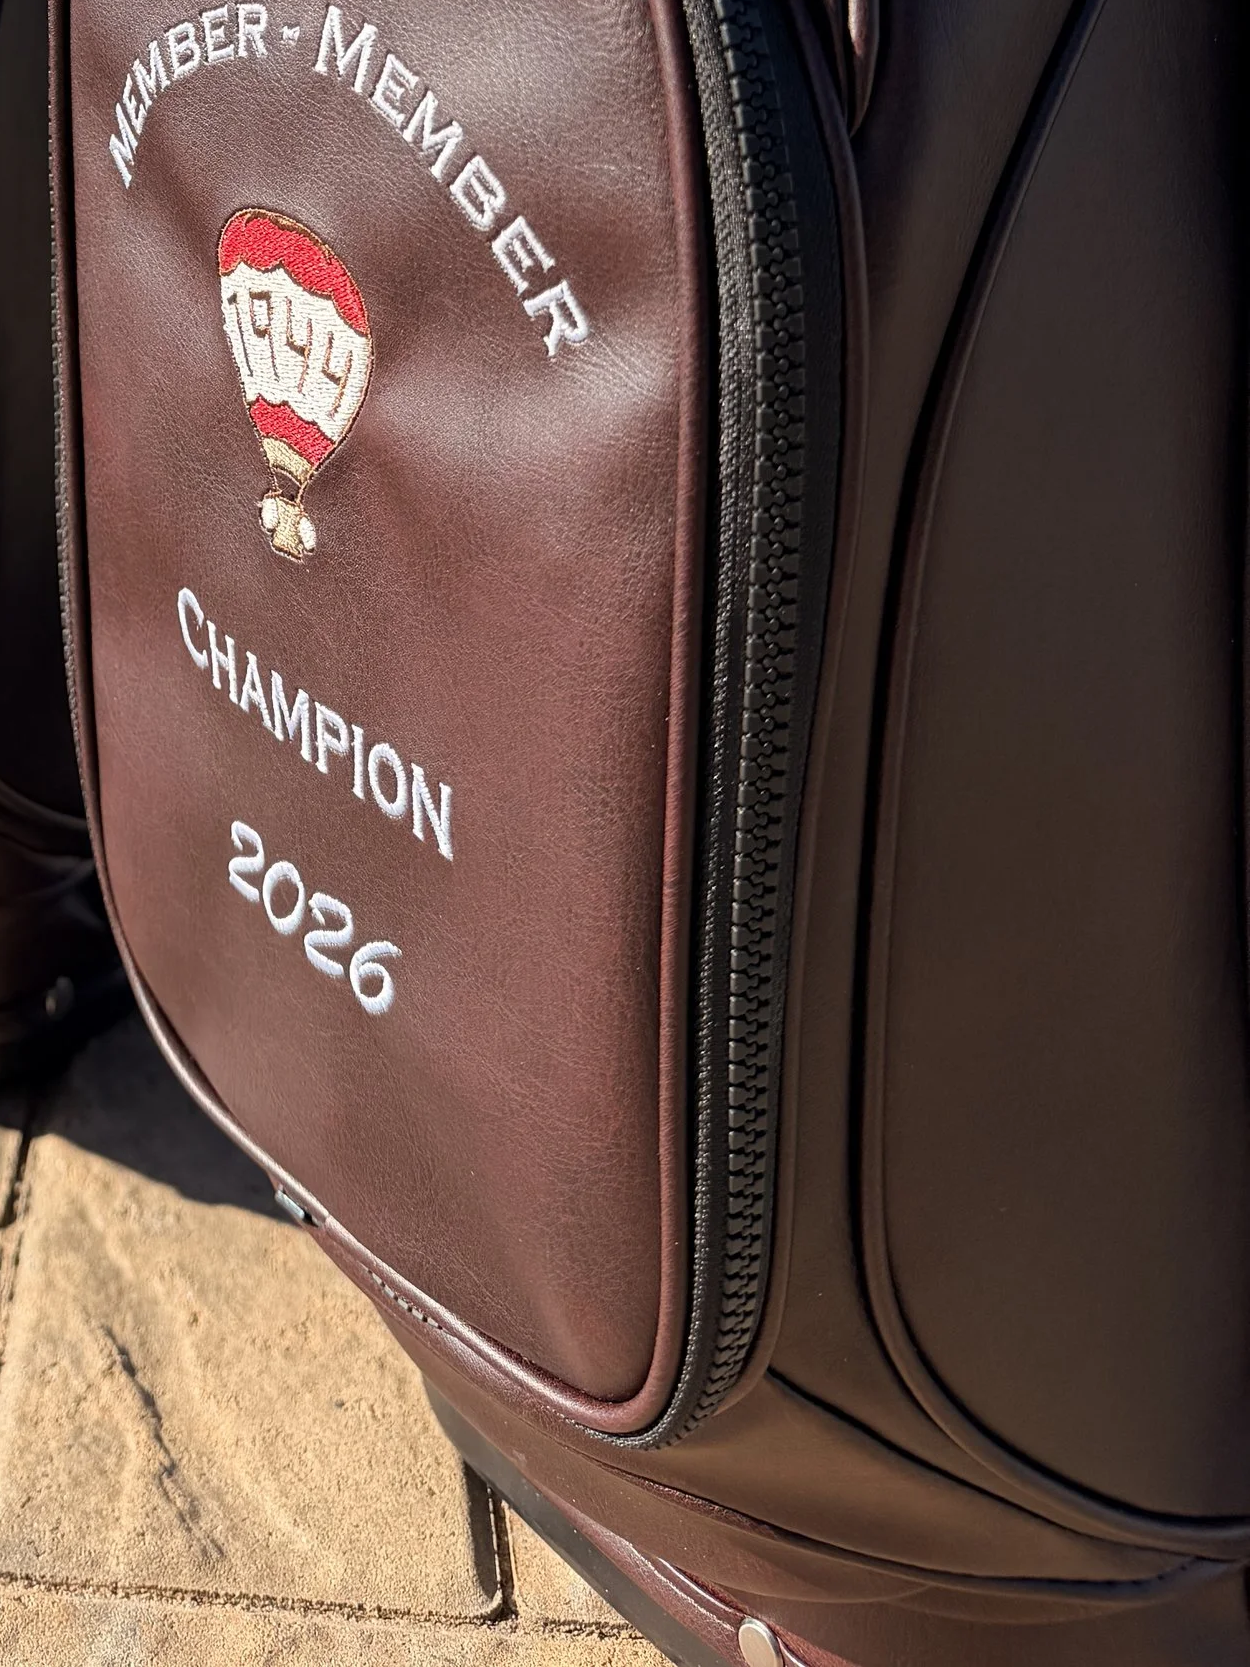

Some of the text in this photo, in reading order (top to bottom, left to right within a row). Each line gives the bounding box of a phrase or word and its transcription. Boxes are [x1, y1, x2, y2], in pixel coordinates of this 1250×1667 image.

[108, 2, 269, 189] MEMBER
[313, 4, 589, 358] MEMBER
[177, 587, 454, 862] CHAMPION
[228, 820, 403, 1016] 2026
